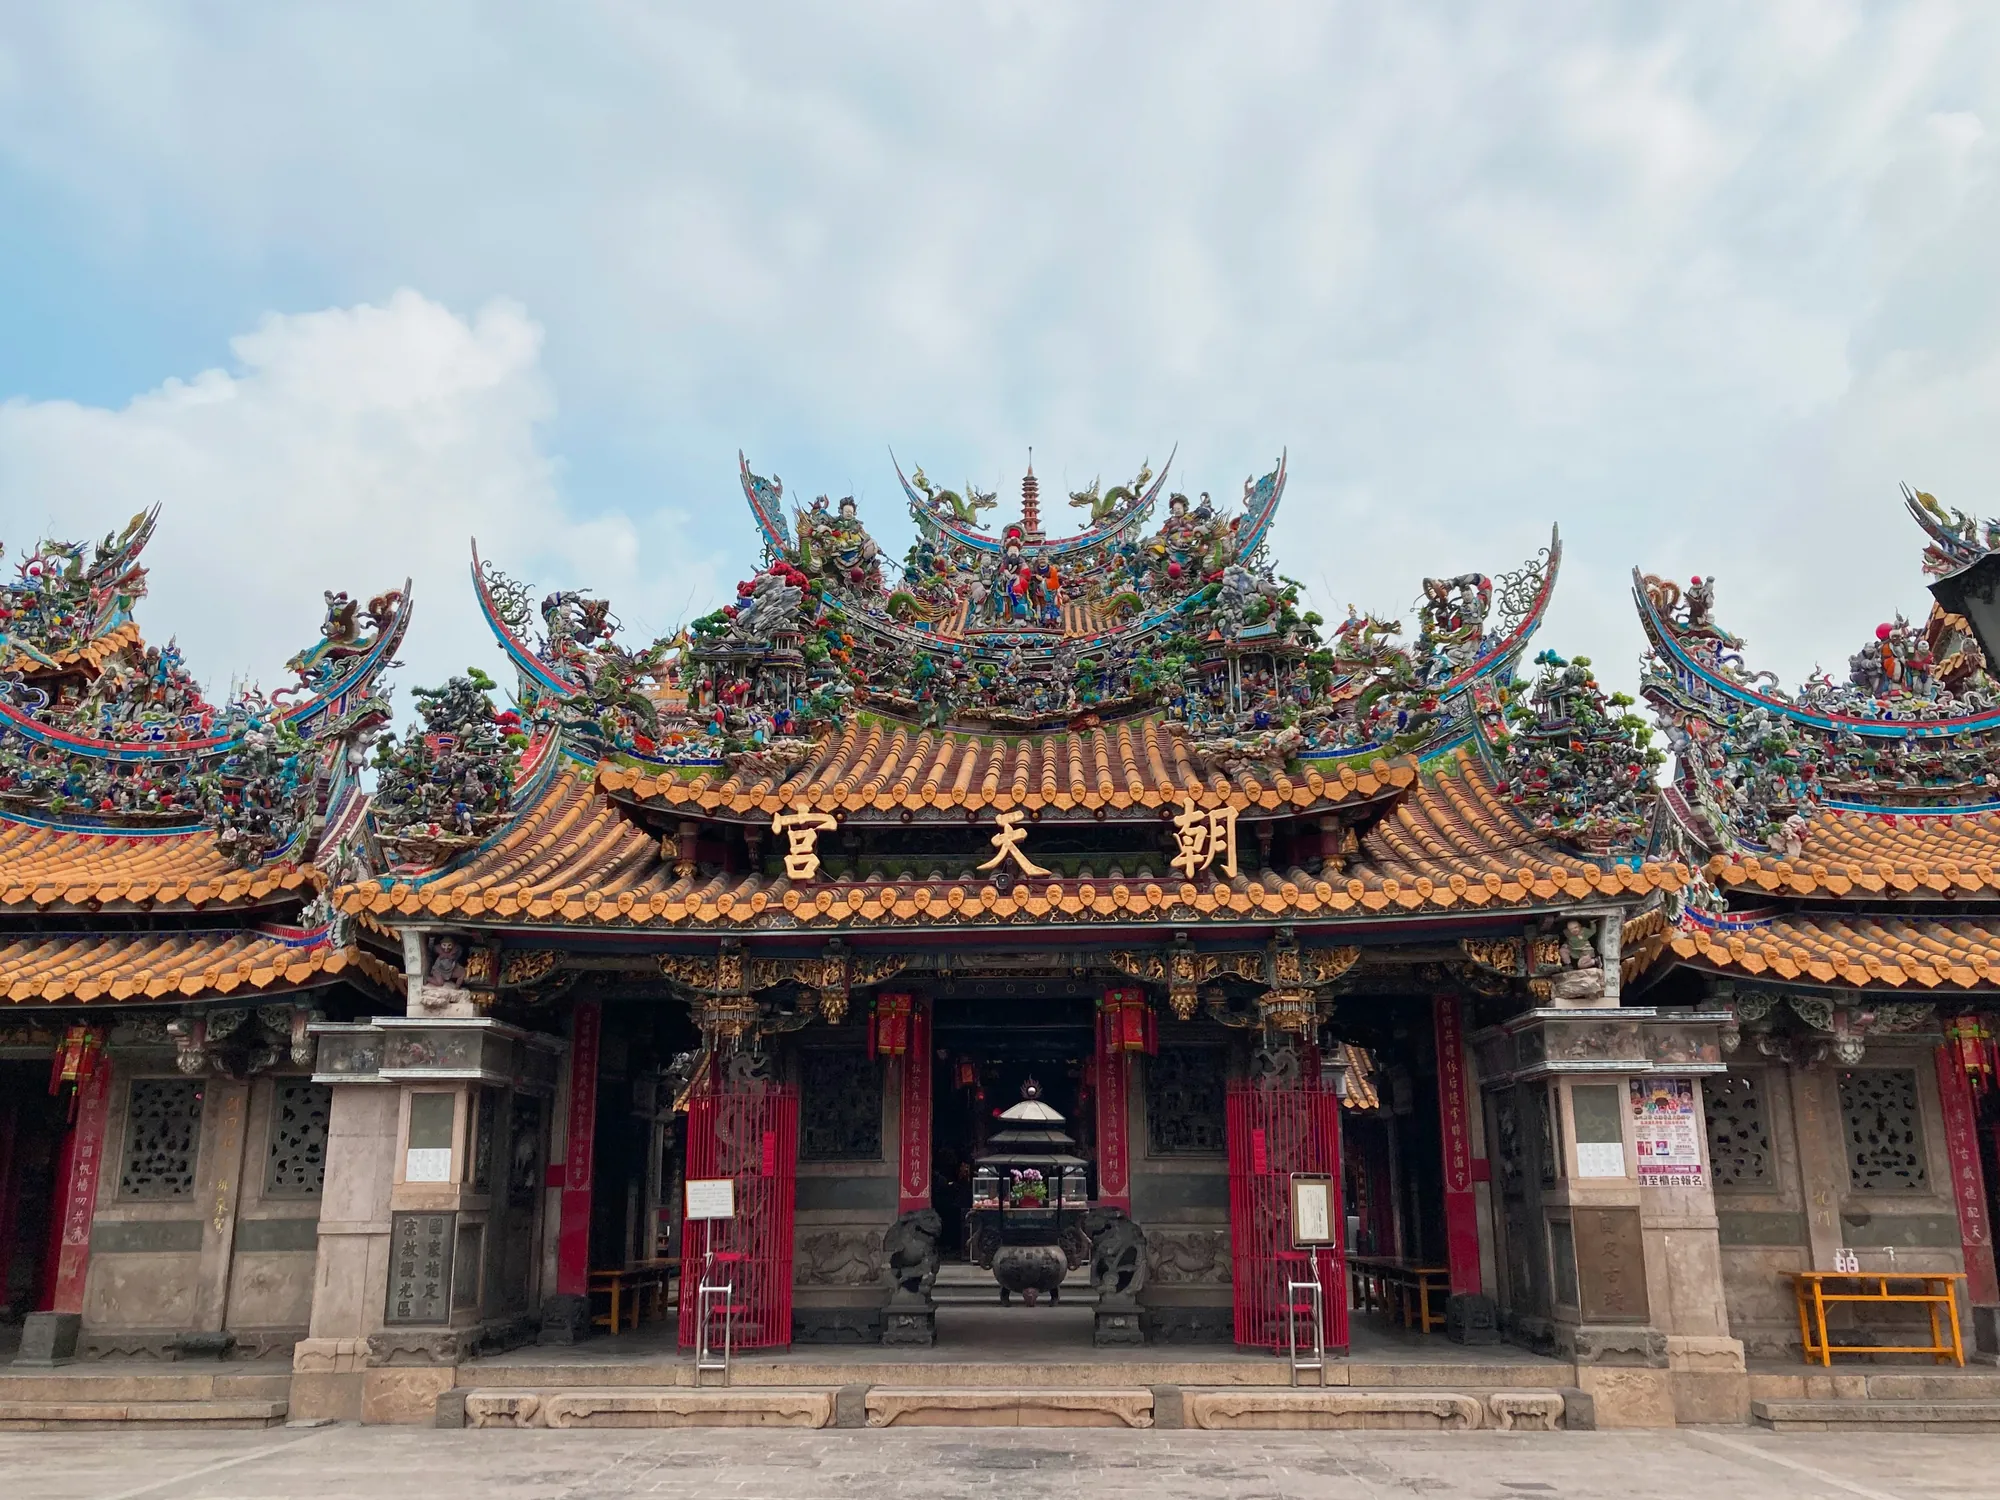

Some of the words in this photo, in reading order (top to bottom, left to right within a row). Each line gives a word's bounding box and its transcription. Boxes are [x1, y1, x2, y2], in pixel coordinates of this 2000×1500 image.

[1638, 1175, 1702, 1186] 請至櫃台報名
[398, 1217, 419, 1317] 宗教觀光區
